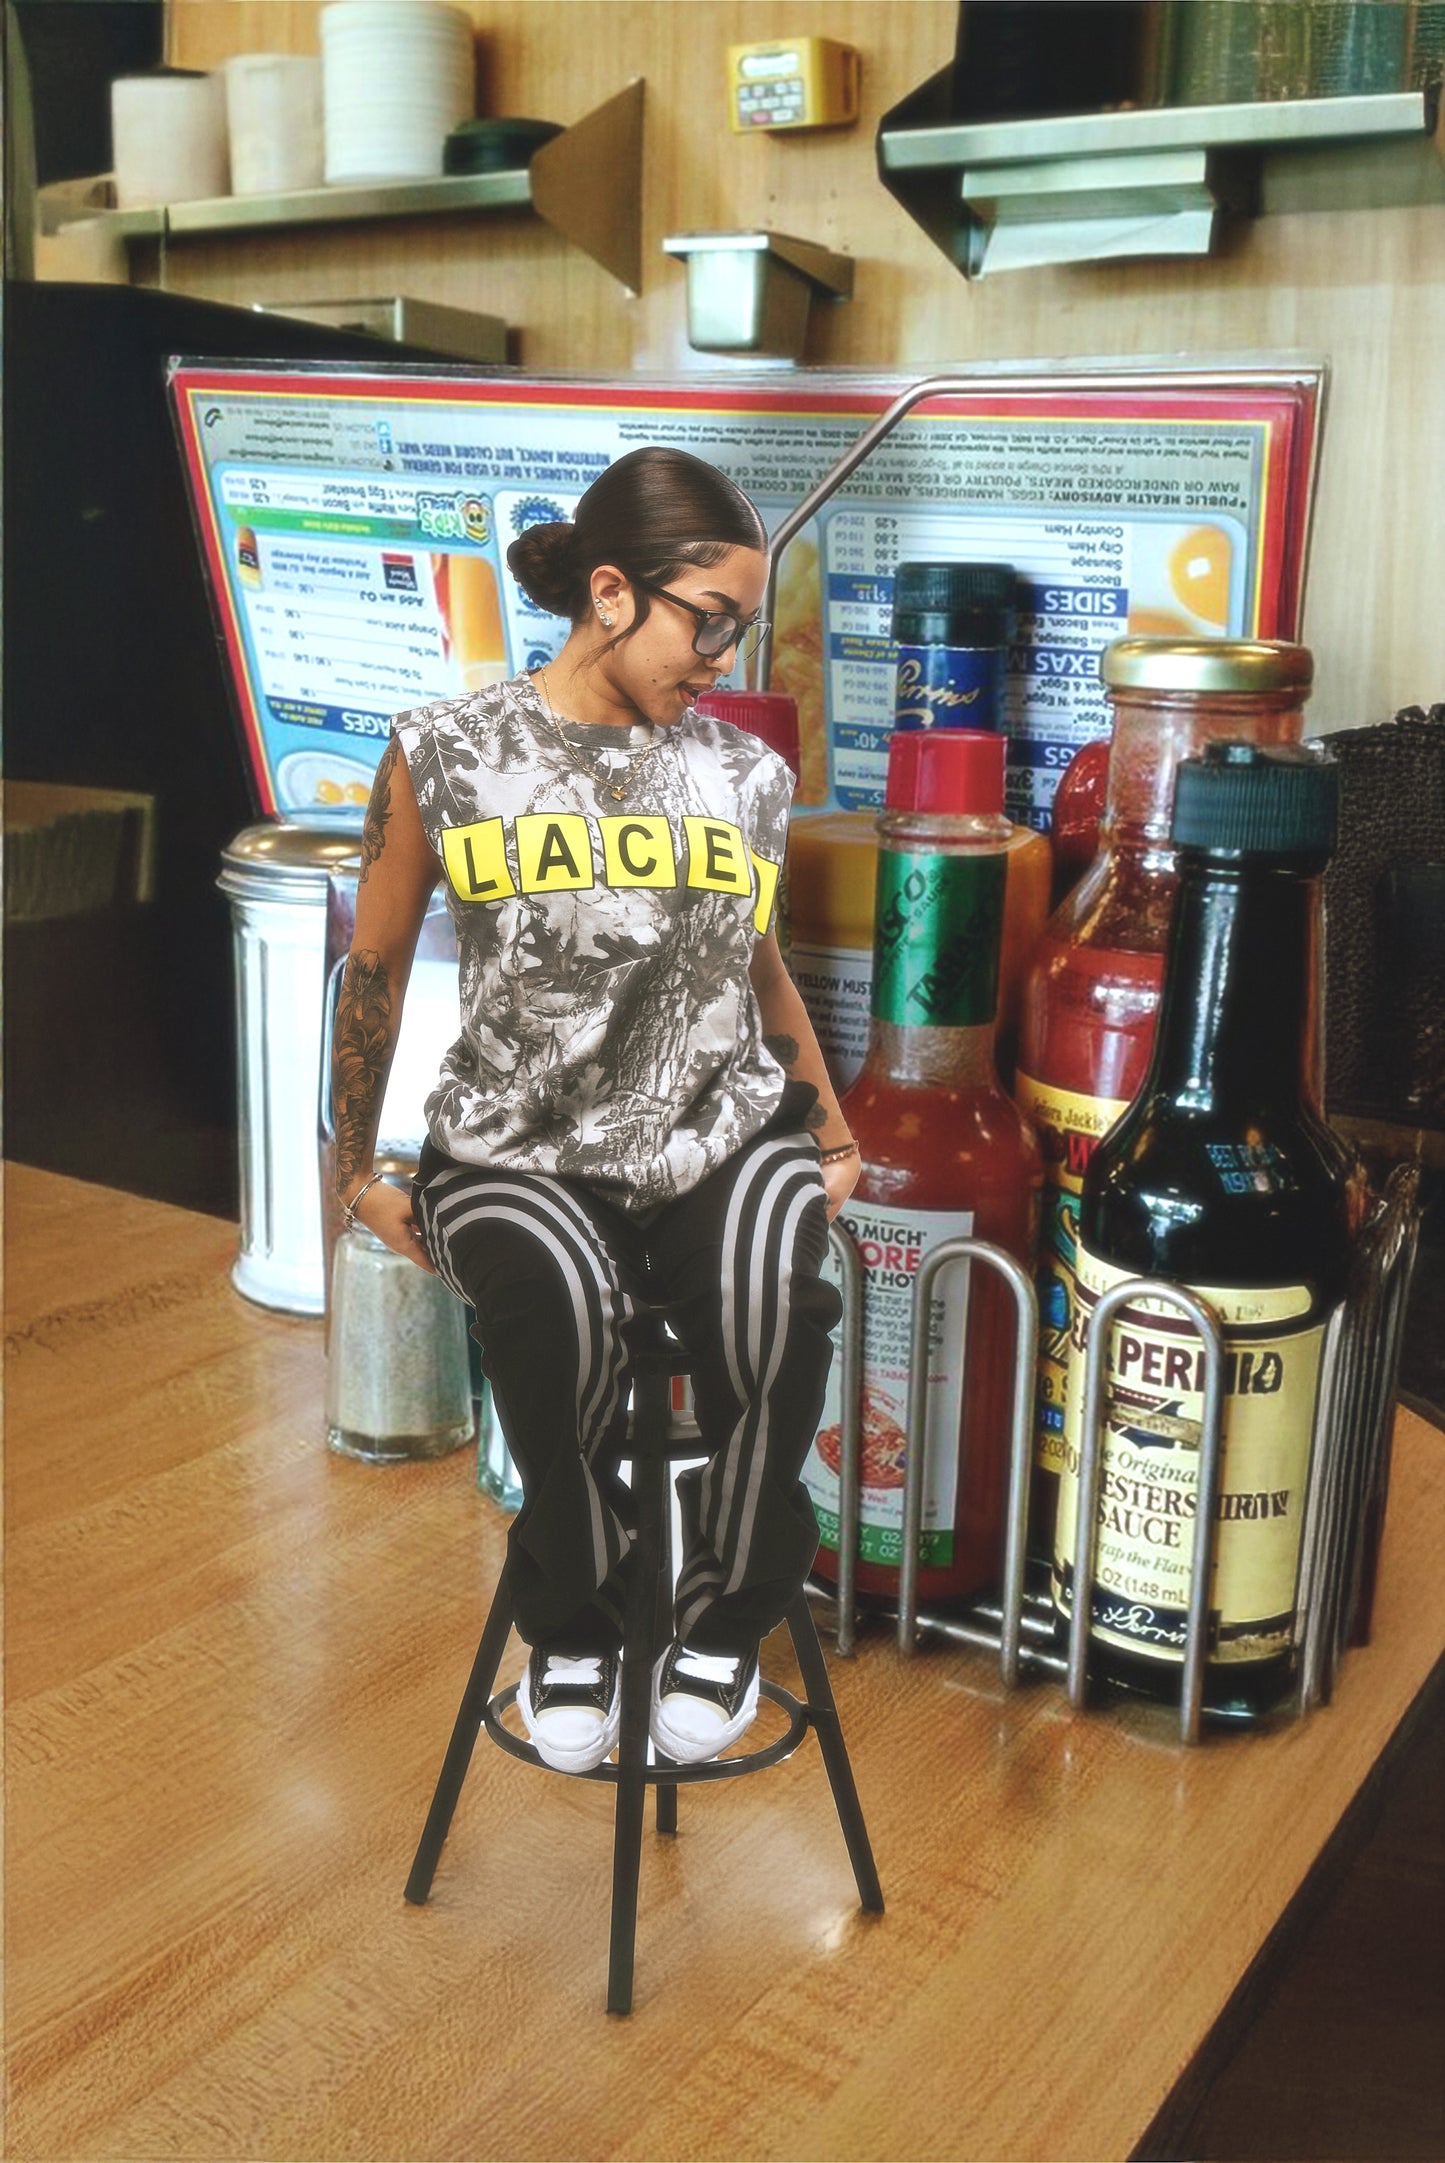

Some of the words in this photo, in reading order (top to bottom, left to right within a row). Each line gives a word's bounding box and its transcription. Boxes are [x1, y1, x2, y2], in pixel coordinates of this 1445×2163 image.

[556, 452, 610, 466] NUTRITION
[533, 467, 580, 480] CALORIES
[753, 468, 778, 477] RISK
[782, 468, 812, 480] YOUR
[877, 472, 903, 483] MAY
[906, 473, 940, 484] EGGS
[741, 480, 787, 492] COOKED
[943, 474, 962, 485] OR
[965, 475, 1021, 486] POULTRY
[1024, 475, 1073, 487] MEATS,
[1078, 478, 1180, 492] UNDERCOOKED
[322, 484, 366, 499] Breakfast
[367, 484, 386, 500] Egg
[789, 481, 805, 492] BE
[885, 485, 911, 497] AND
[914, 485, 1004, 499] HAMBURGERS,
[1184, 481, 1204, 492] OR
[1208, 481, 1240, 493] RAW
[1007, 488, 1045, 501] EGGS,
[1049, 491, 1123, 504] ADVISORY:
[1126, 493, 1180, 505] HEALTH
[321, 499, 351, 511] Bacon
[368, 502, 397, 515] Waffle
[875, 517, 897, 532] 4.25
[1044, 525, 1072, 536] Ham
[1075, 524, 1123, 538] Country
[1068, 542, 1096, 554] Ham
[1099, 541, 1123, 555] City
[1071, 556, 1123, 571] Sausage
[1083, 575, 1121, 587] Bacon
[1044, 590, 1117, 614] SIDES
[1048, 617, 1088, 630] Bacon,
[1034, 633, 1088, 648] Sausage,
[1071, 681, 1081, 691] &
[462, 822, 757, 912] LACE
[797, 973, 840, 991] YELLOW
[843, 978, 872, 995] MUST
[858, 1241, 922, 1273] ORE
